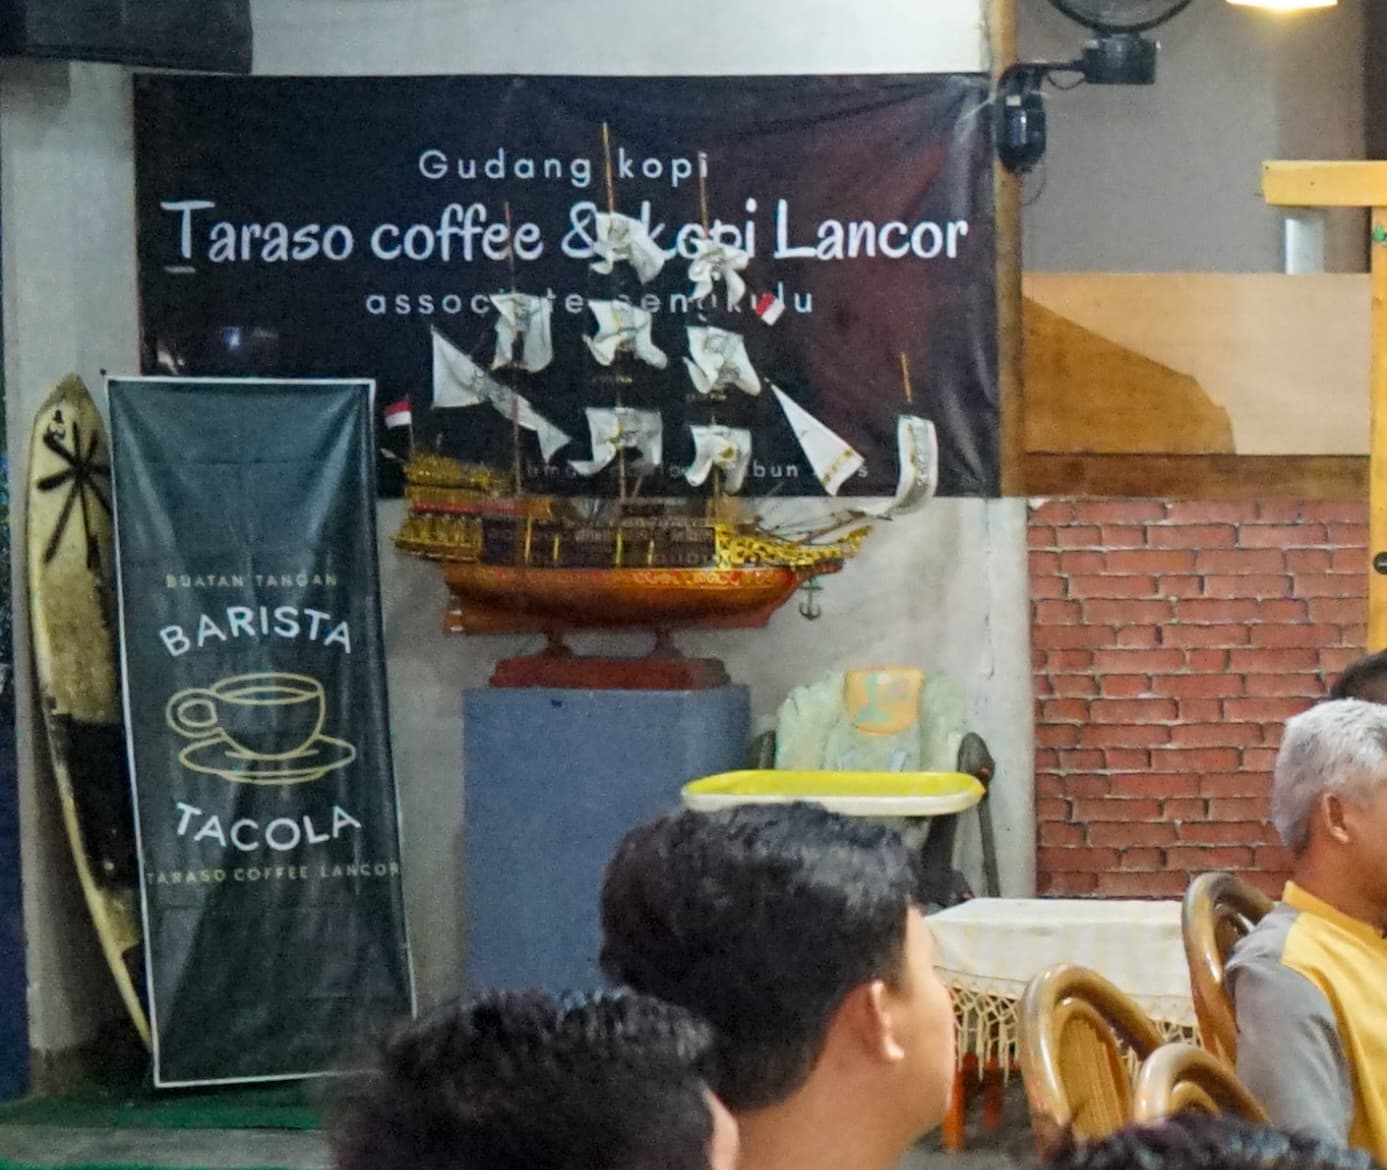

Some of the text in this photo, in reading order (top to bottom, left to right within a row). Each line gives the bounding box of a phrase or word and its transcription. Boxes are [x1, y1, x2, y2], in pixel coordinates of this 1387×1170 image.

[418, 147, 707, 188] Gudang kopi
[160, 200, 354, 263] Taraso
[370, 202, 544, 263] coffee
[773, 198, 969, 261] Lancor
[365, 287, 585, 314] assocte
[165, 574, 337, 588] BUATAN TANGAN
[159, 605, 351, 656] BARISTA
[176, 801, 362, 851] TACOLA
[146, 861, 400, 885] TARASO COFFEE LANCOR
